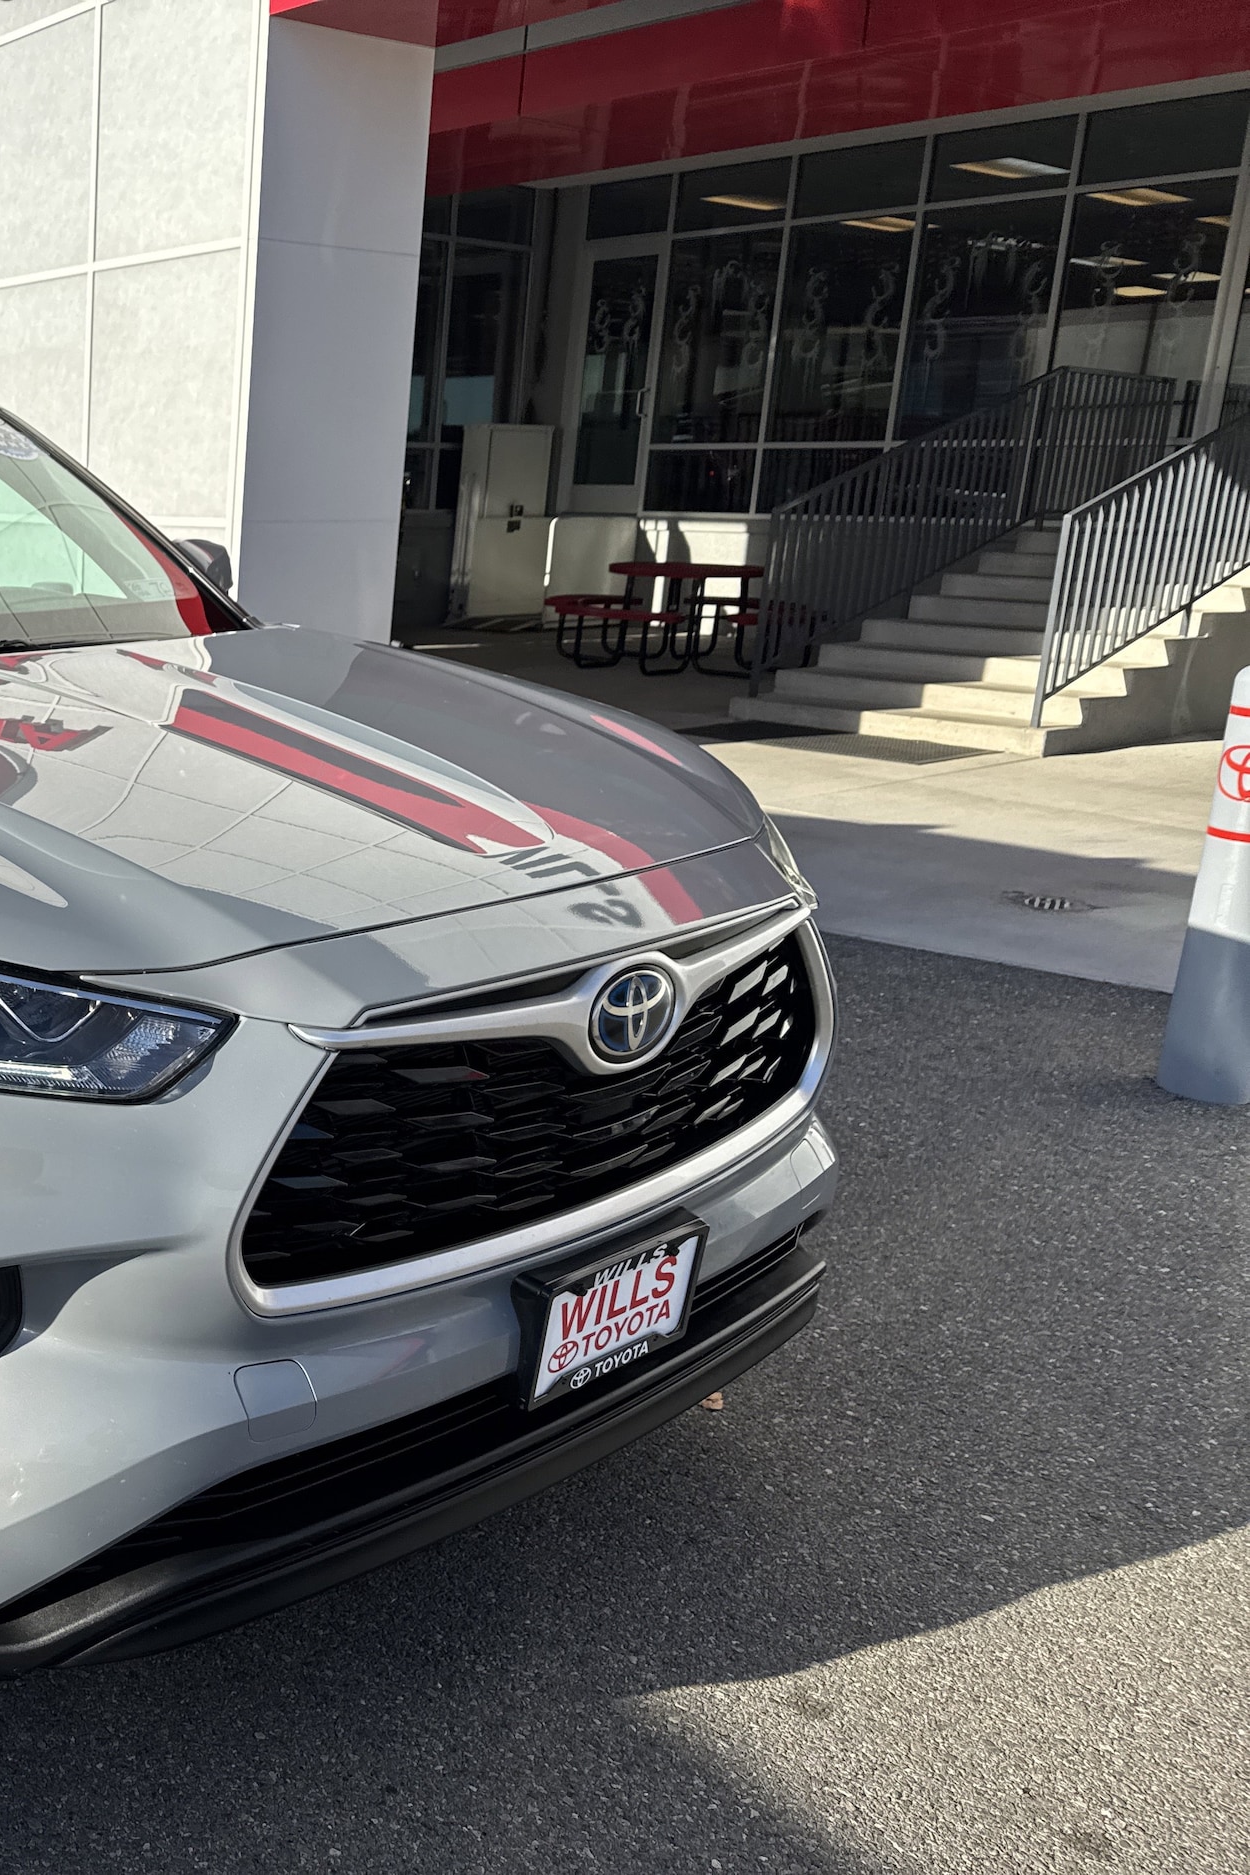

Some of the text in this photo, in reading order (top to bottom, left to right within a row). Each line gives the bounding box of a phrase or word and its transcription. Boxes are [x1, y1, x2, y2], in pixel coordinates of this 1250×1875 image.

[593, 1243, 668, 1288] WILLS
[561, 1255, 678, 1341] WILLS
[581, 1299, 671, 1358] TOYOTA
[594, 1340, 649, 1378] TOYOTA
